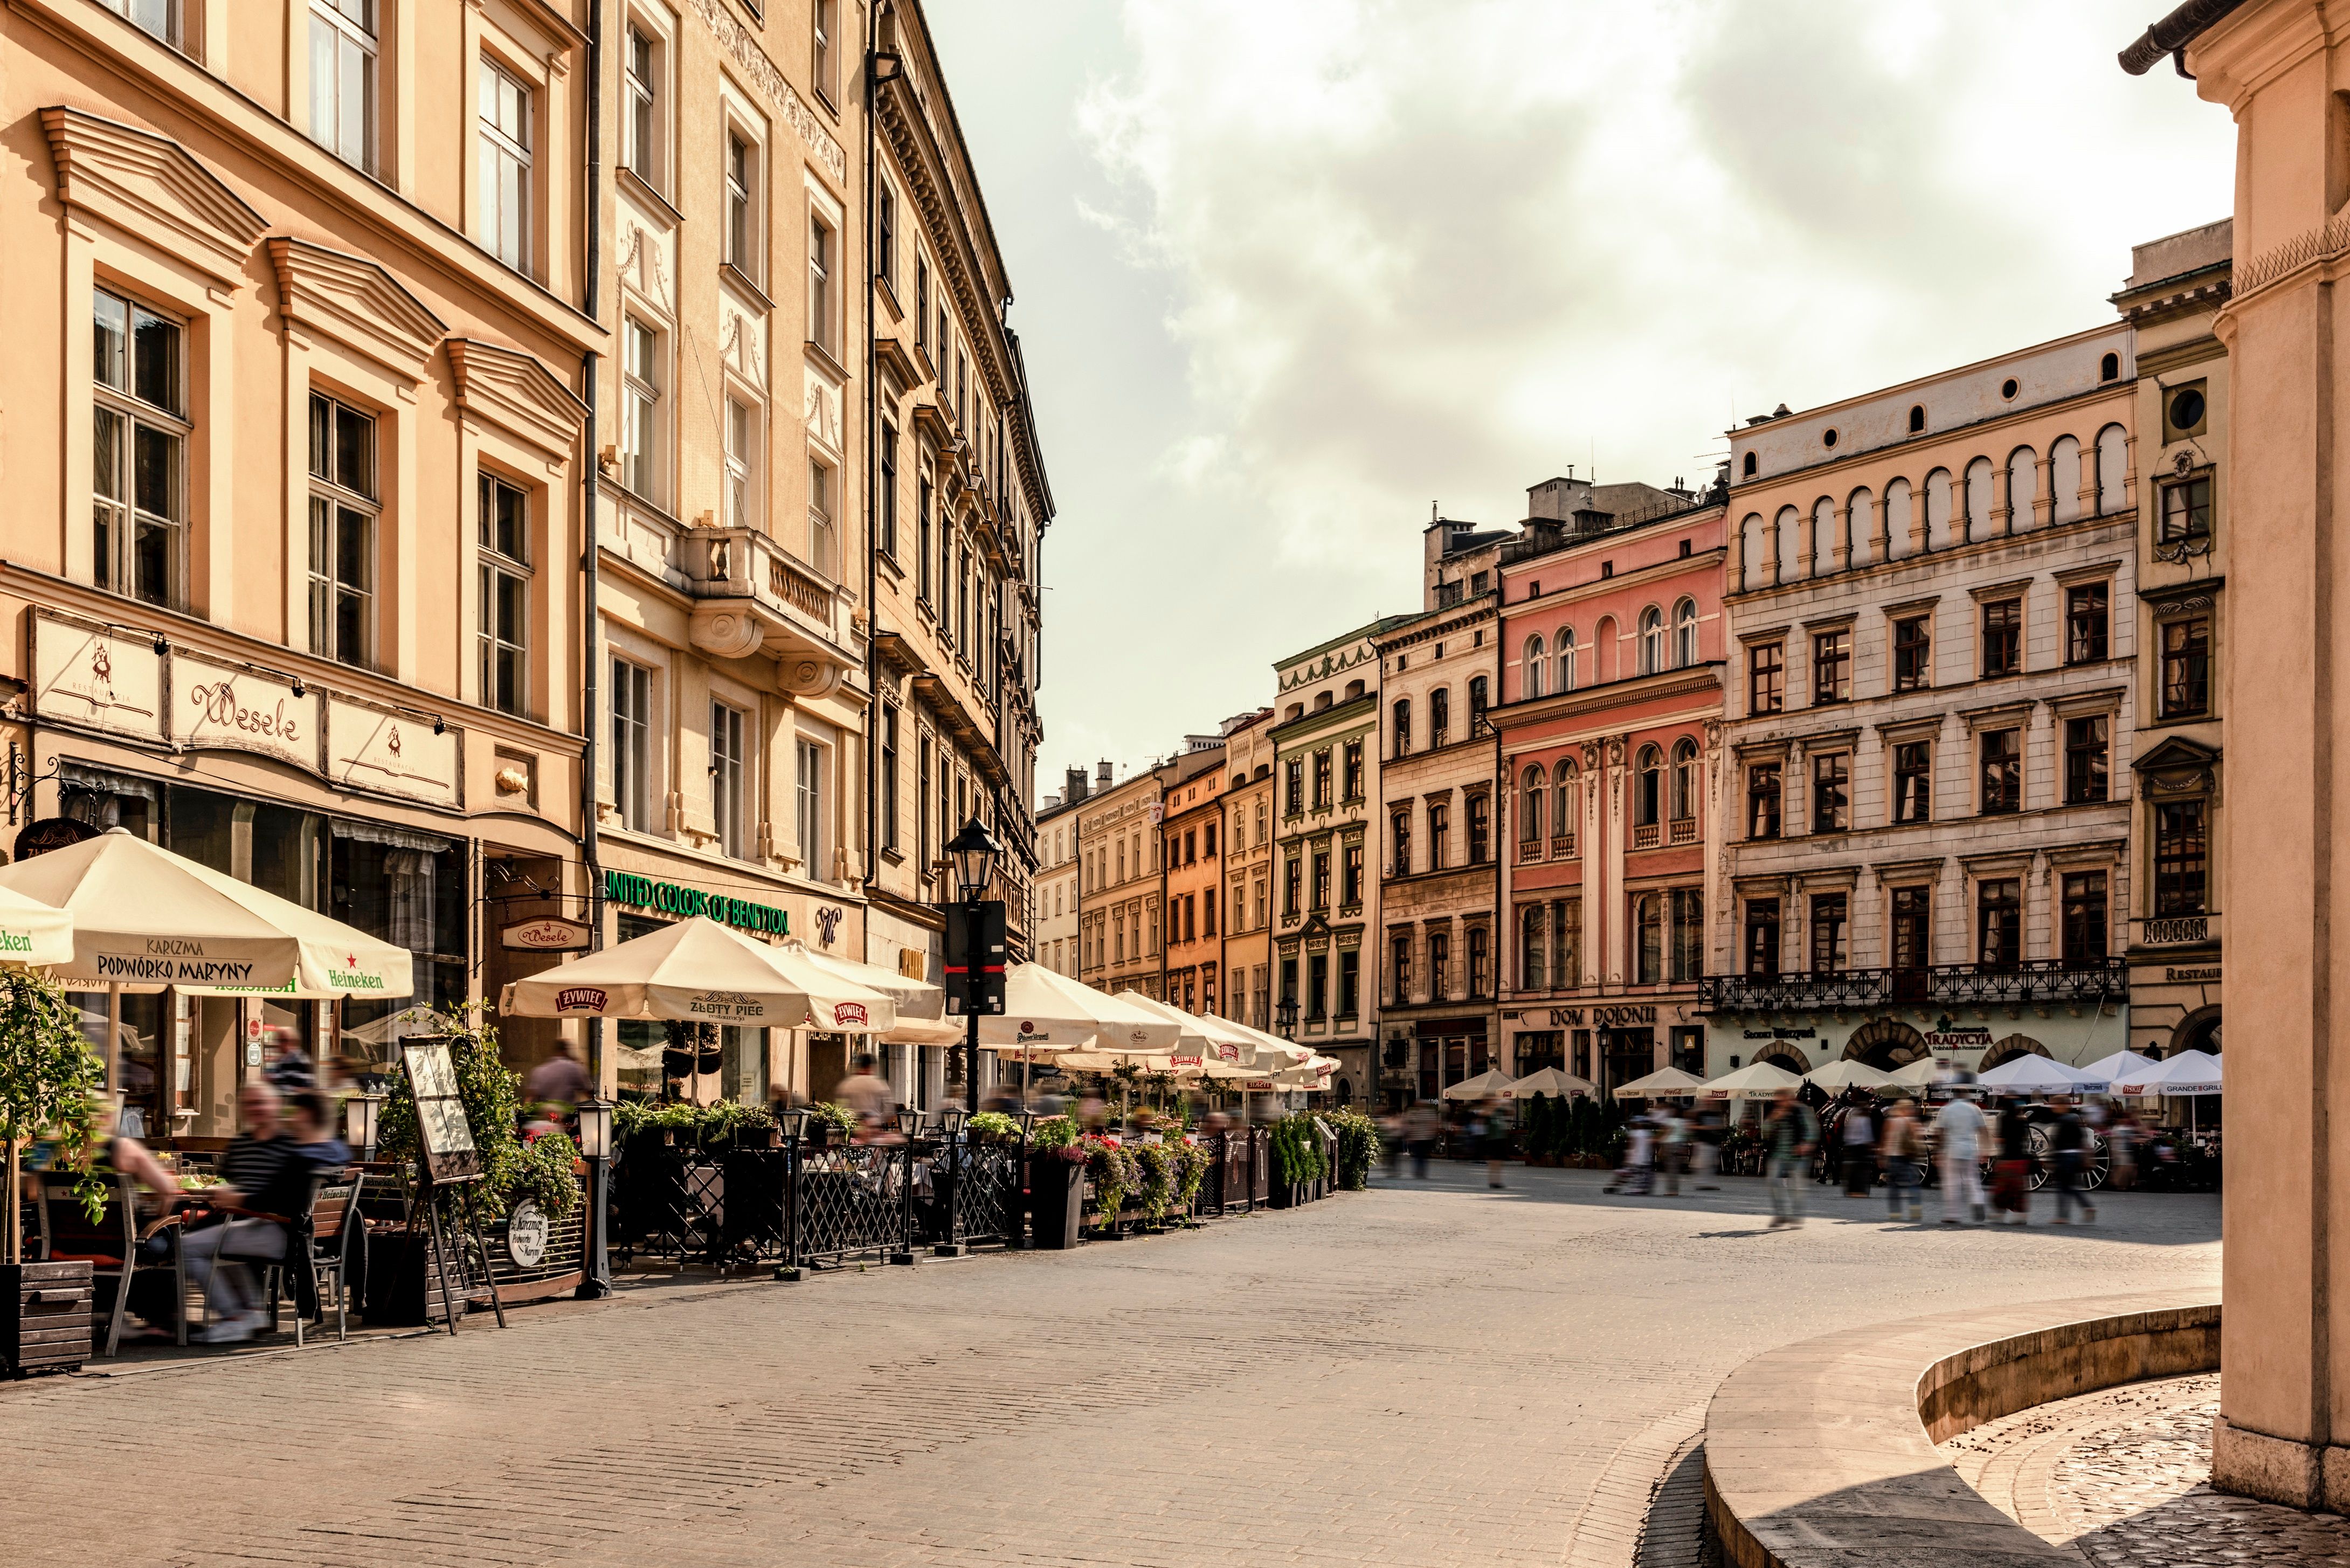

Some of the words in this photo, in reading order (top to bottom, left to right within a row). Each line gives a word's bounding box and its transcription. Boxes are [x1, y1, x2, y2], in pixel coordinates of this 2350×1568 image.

[73, 682, 130, 703] RESTAURCJA
[191, 681, 300, 741] Wesele
[374, 757, 415, 772] RESTAURACJA
[605, 870, 654, 907] UNITED
[655, 882, 708, 916] COLORS
[710, 895, 729, 922] OF
[522, 929, 568, 942] Wesele
[147, 938, 204, 956] KARCZMA
[98, 955, 173, 979] PODWÓRKO
[178, 962, 253, 981] MARYNY
[328, 970, 384, 989] Heineken
[563, 990, 602, 1005] ŻYWIEC
[690, 1002, 731, 1014] ZŁOTY
[736, 1005, 763, 1016] PIEC
[838, 1005, 863, 1019] ŻYWIEC
[708, 1014, 744, 1022] restauracja
[1550, 1009, 1584, 1026] DOM
[808, 1031, 831, 1041] ALAGA
[1017, 1032, 1033, 1044] Pilsner
[1033, 1032, 1049, 1041] Urquell
[1318, 1064, 1330, 1075] TYSKIE
[322, 1190, 349, 1199] Heineken
[517, 1217, 540, 1231] Karczma
[524, 1245, 540, 1259] Maryny
